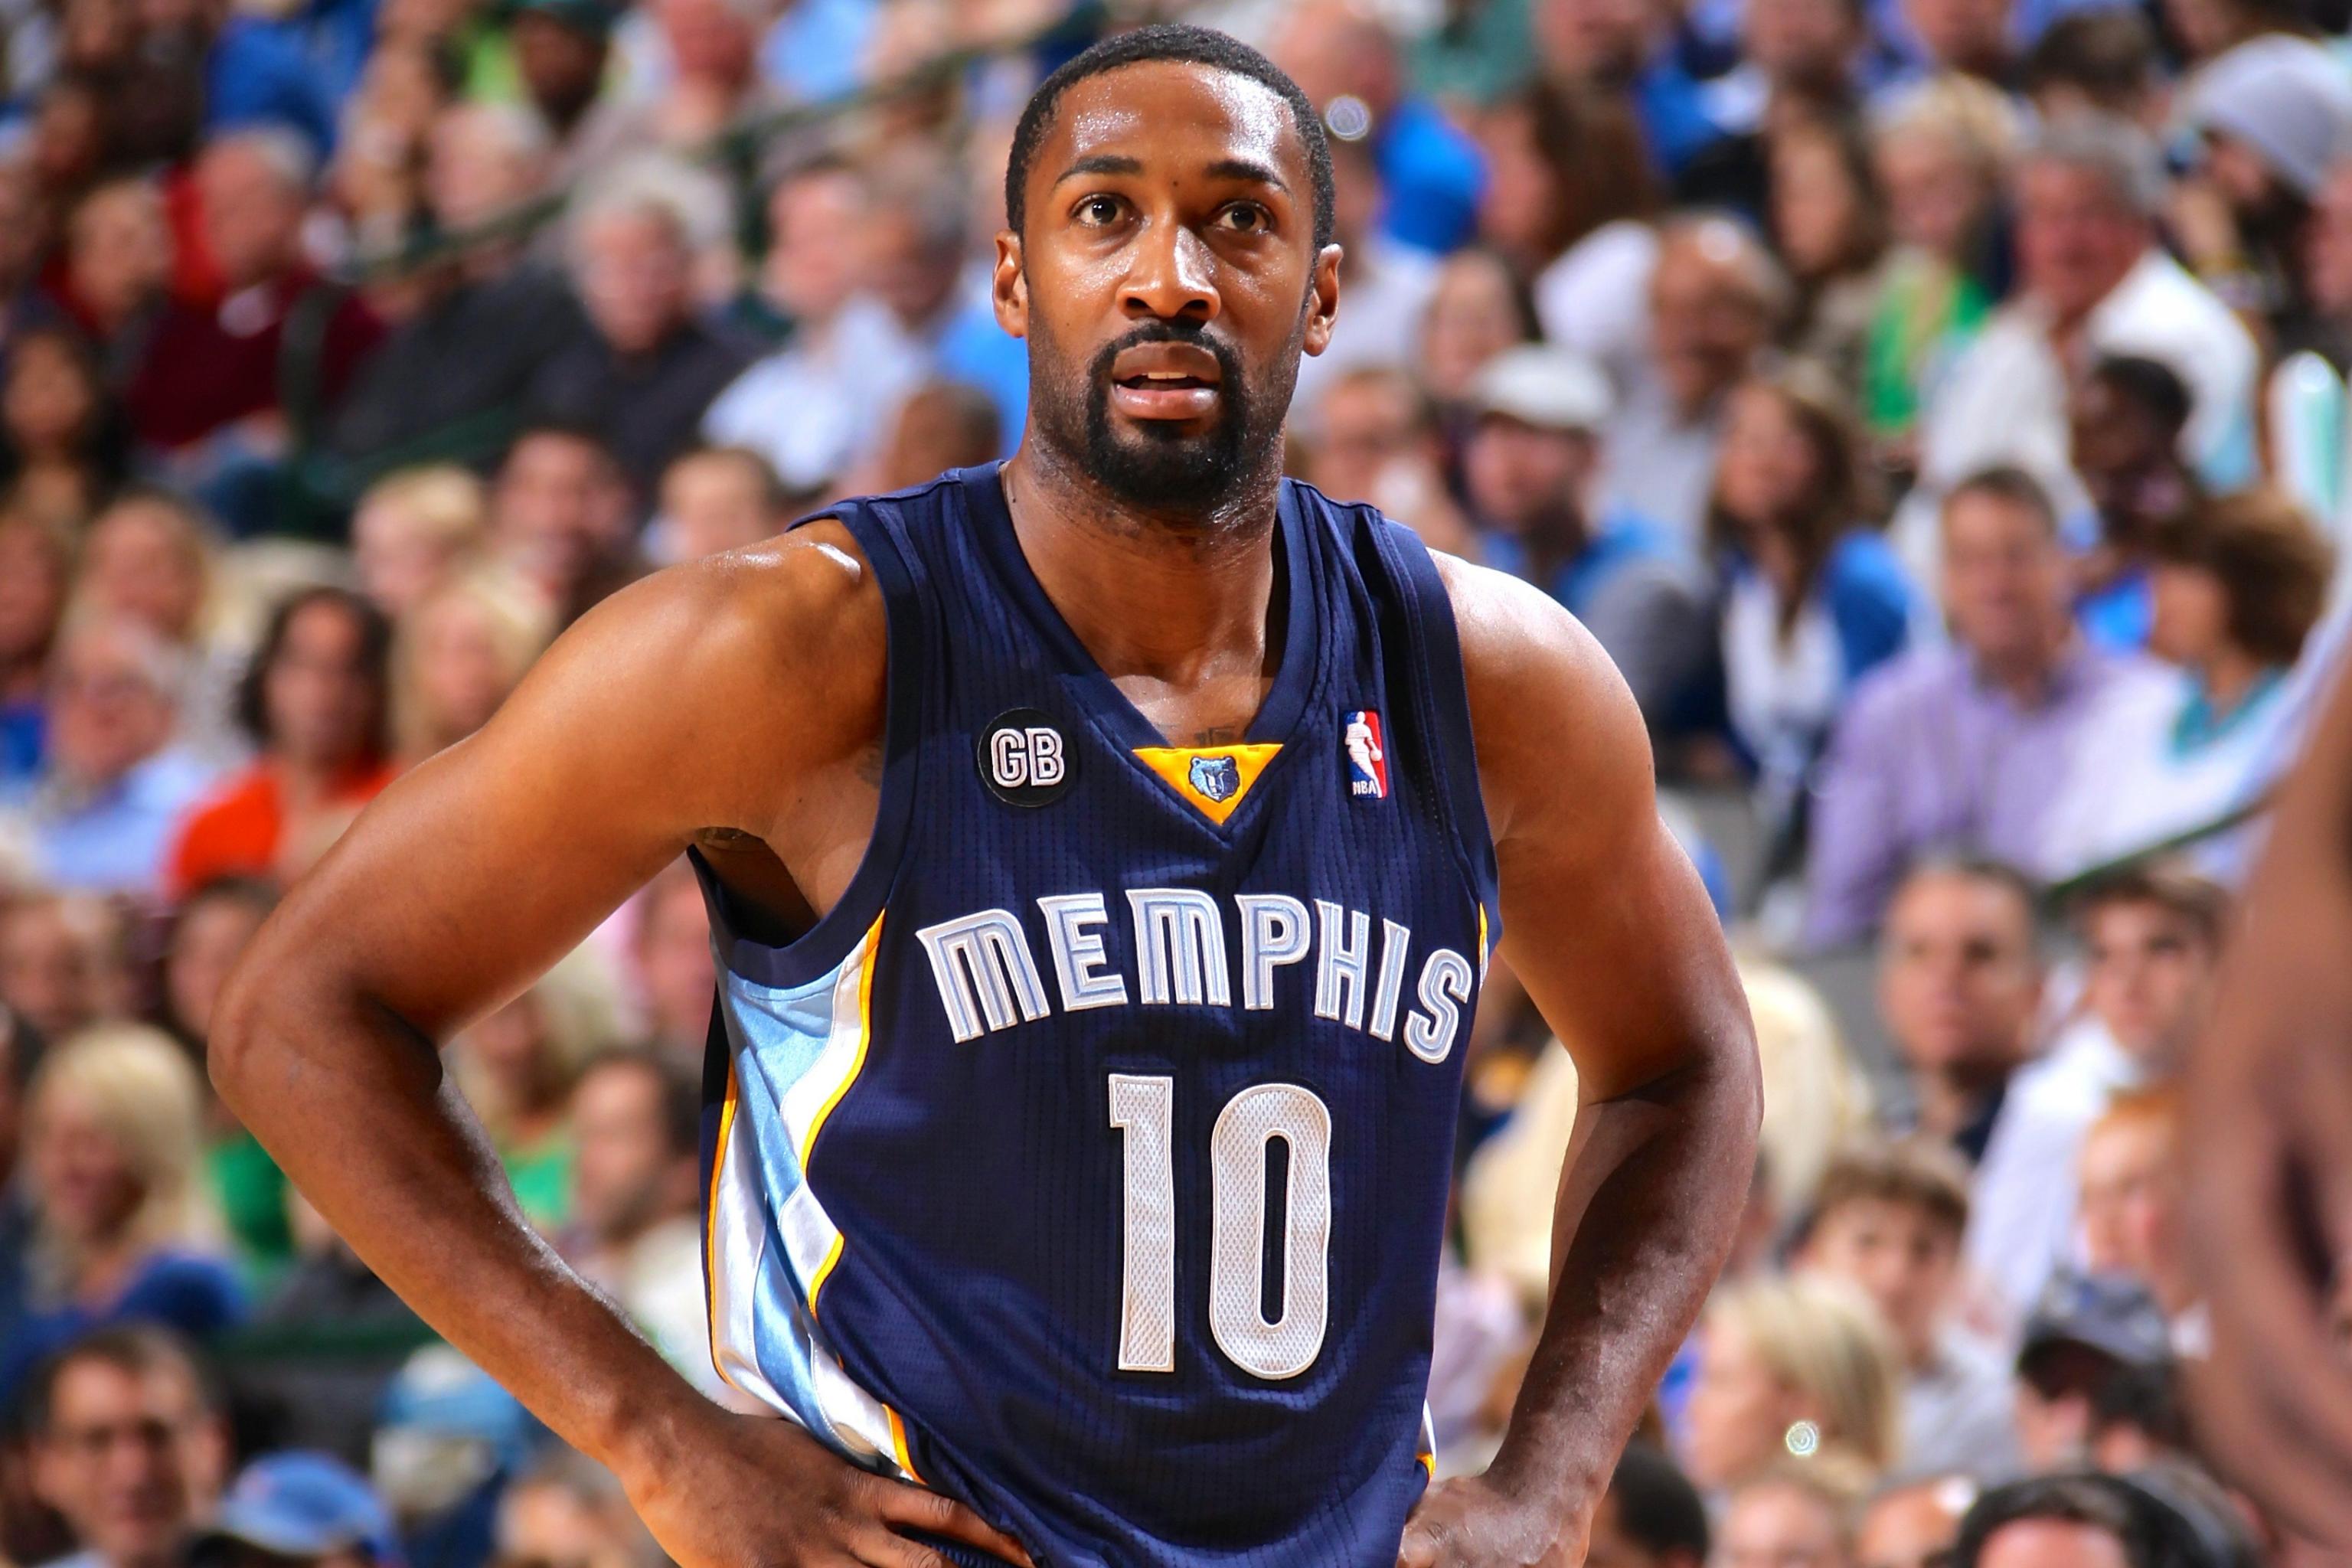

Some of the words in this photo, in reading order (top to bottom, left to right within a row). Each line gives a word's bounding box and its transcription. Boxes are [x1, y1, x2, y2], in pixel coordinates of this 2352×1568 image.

[990, 727, 1066, 788] GB
[1352, 780, 1377, 795] NBA
[916, 887, 1472, 1063] MEMPHIS
[1109, 1073, 1331, 1380] 10
